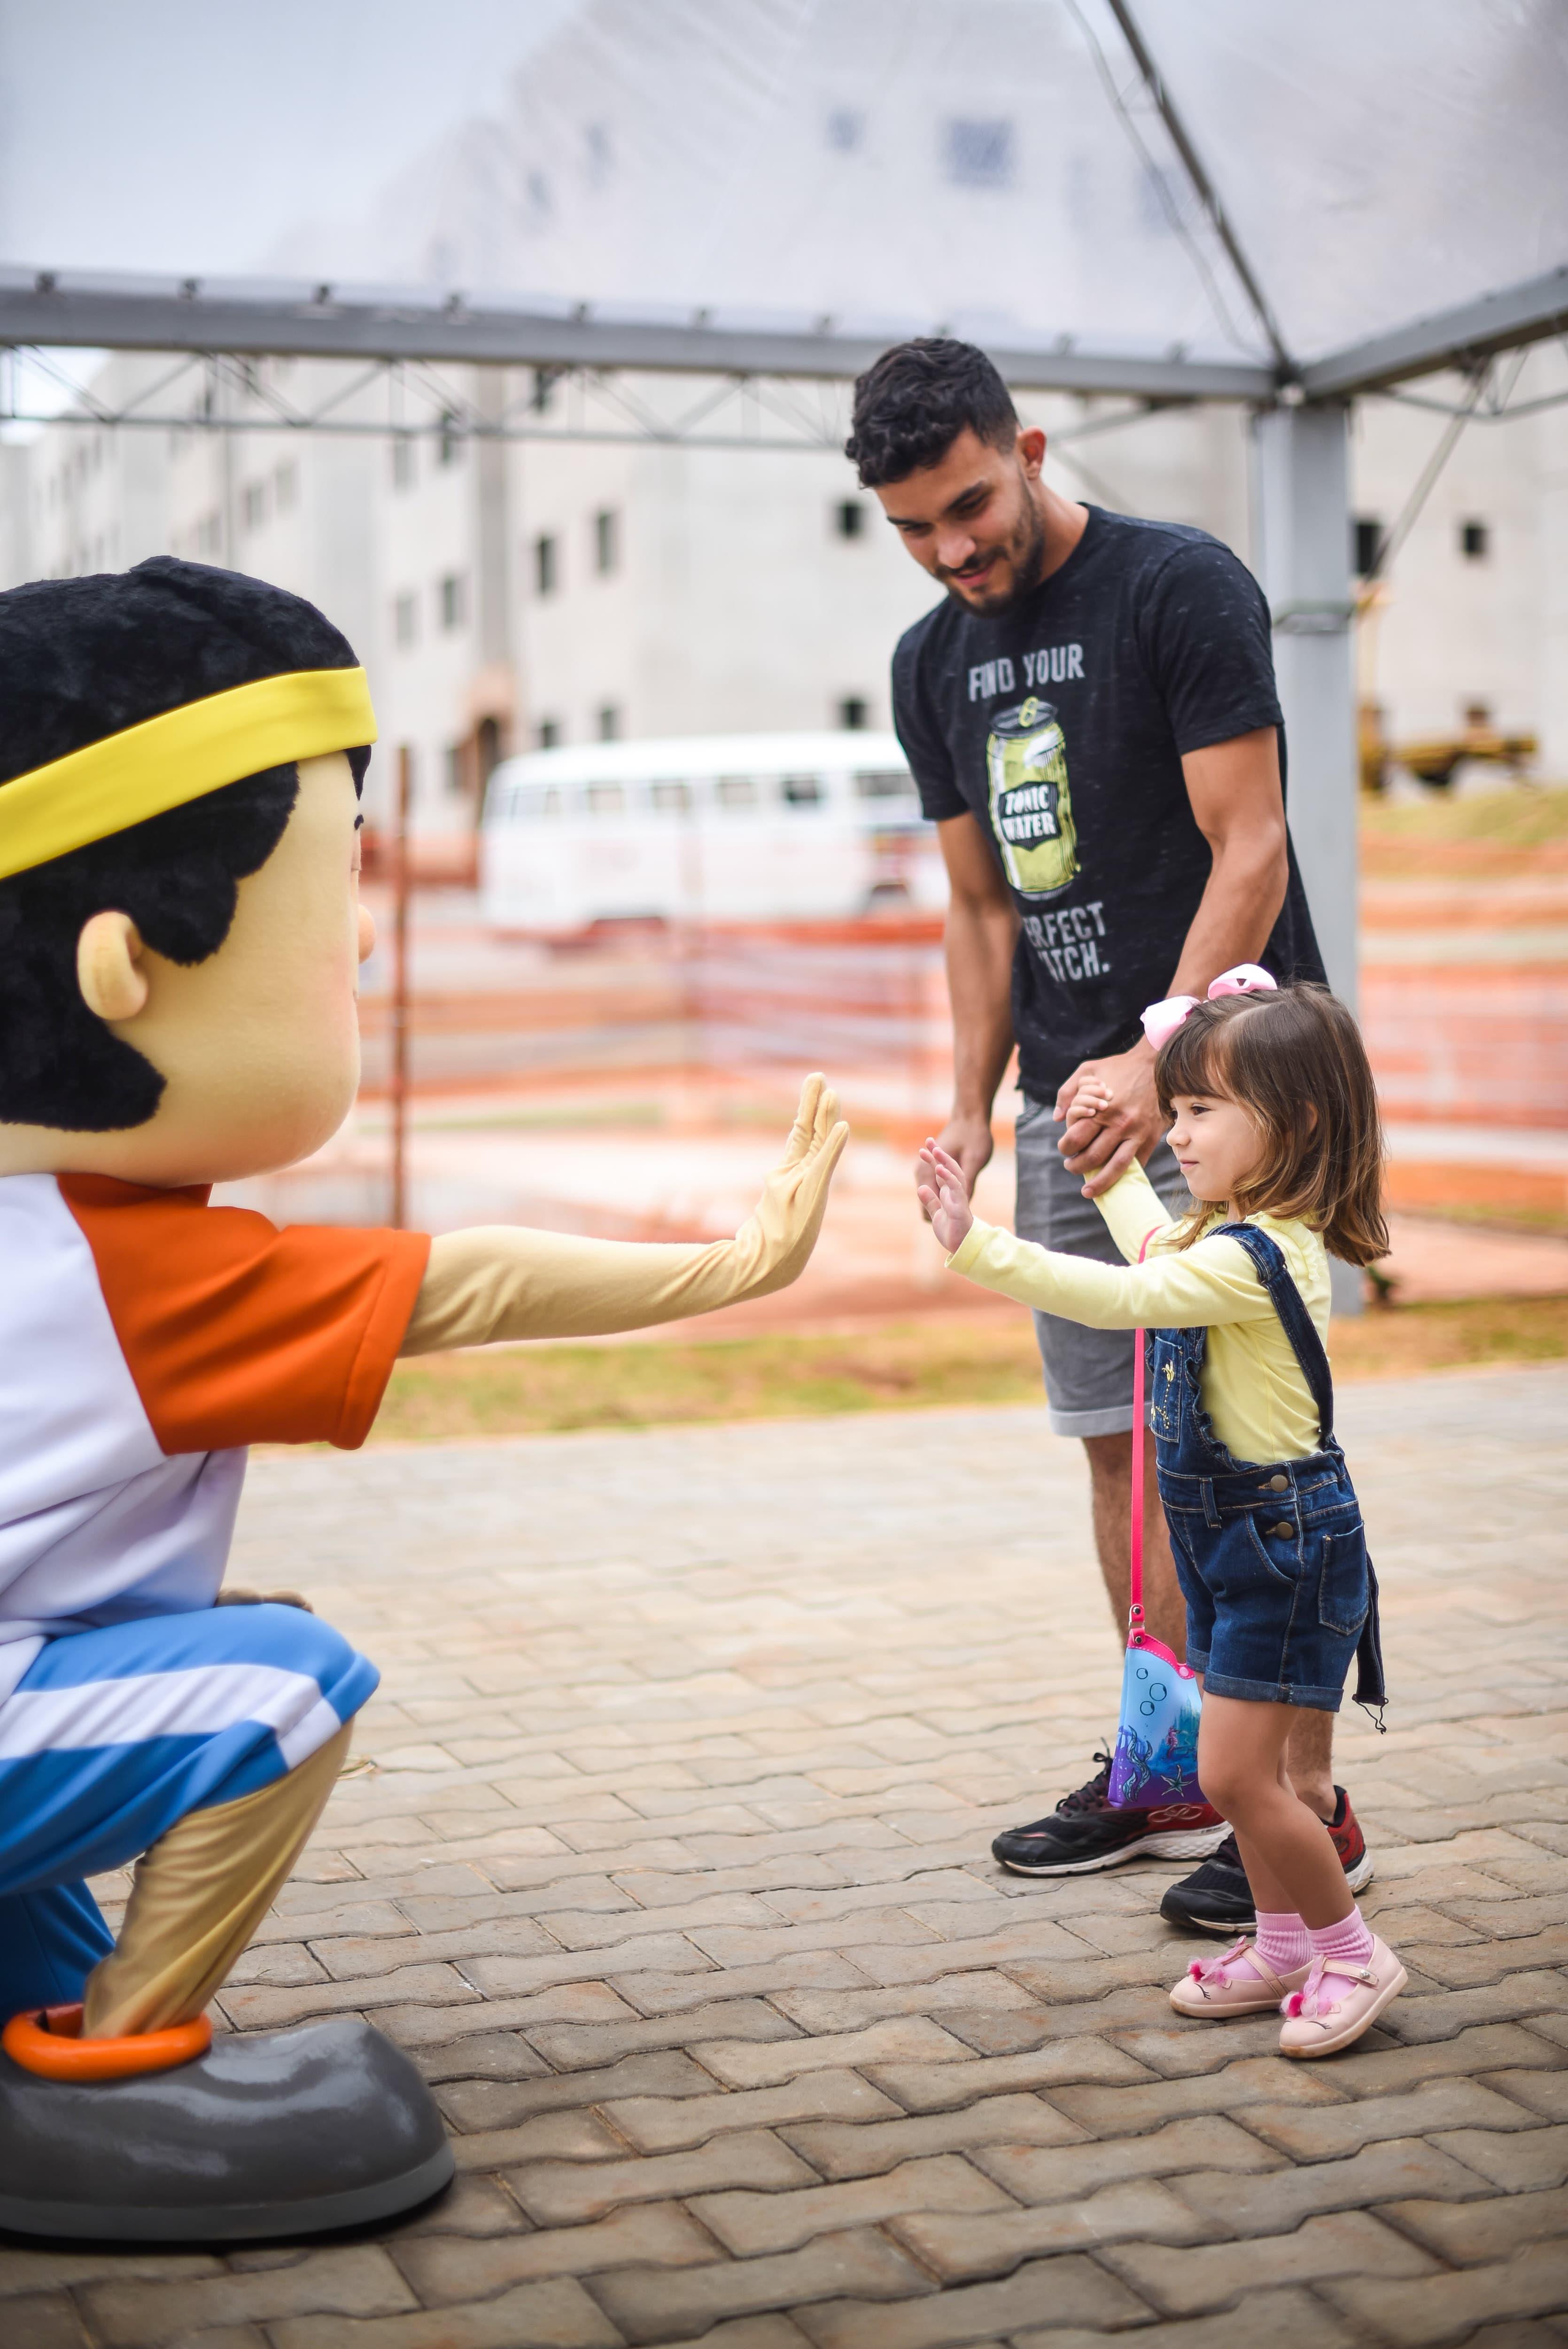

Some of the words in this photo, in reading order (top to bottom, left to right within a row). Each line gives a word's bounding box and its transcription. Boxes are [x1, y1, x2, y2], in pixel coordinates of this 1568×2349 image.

[1022, 643, 1085, 688] YOUR
[1005, 784, 1050, 816] TONIC
[1001, 810, 1056, 841] WATER
[1022, 901, 1105, 948] RFECT
[1038, 941, 1110, 981] TCH.
